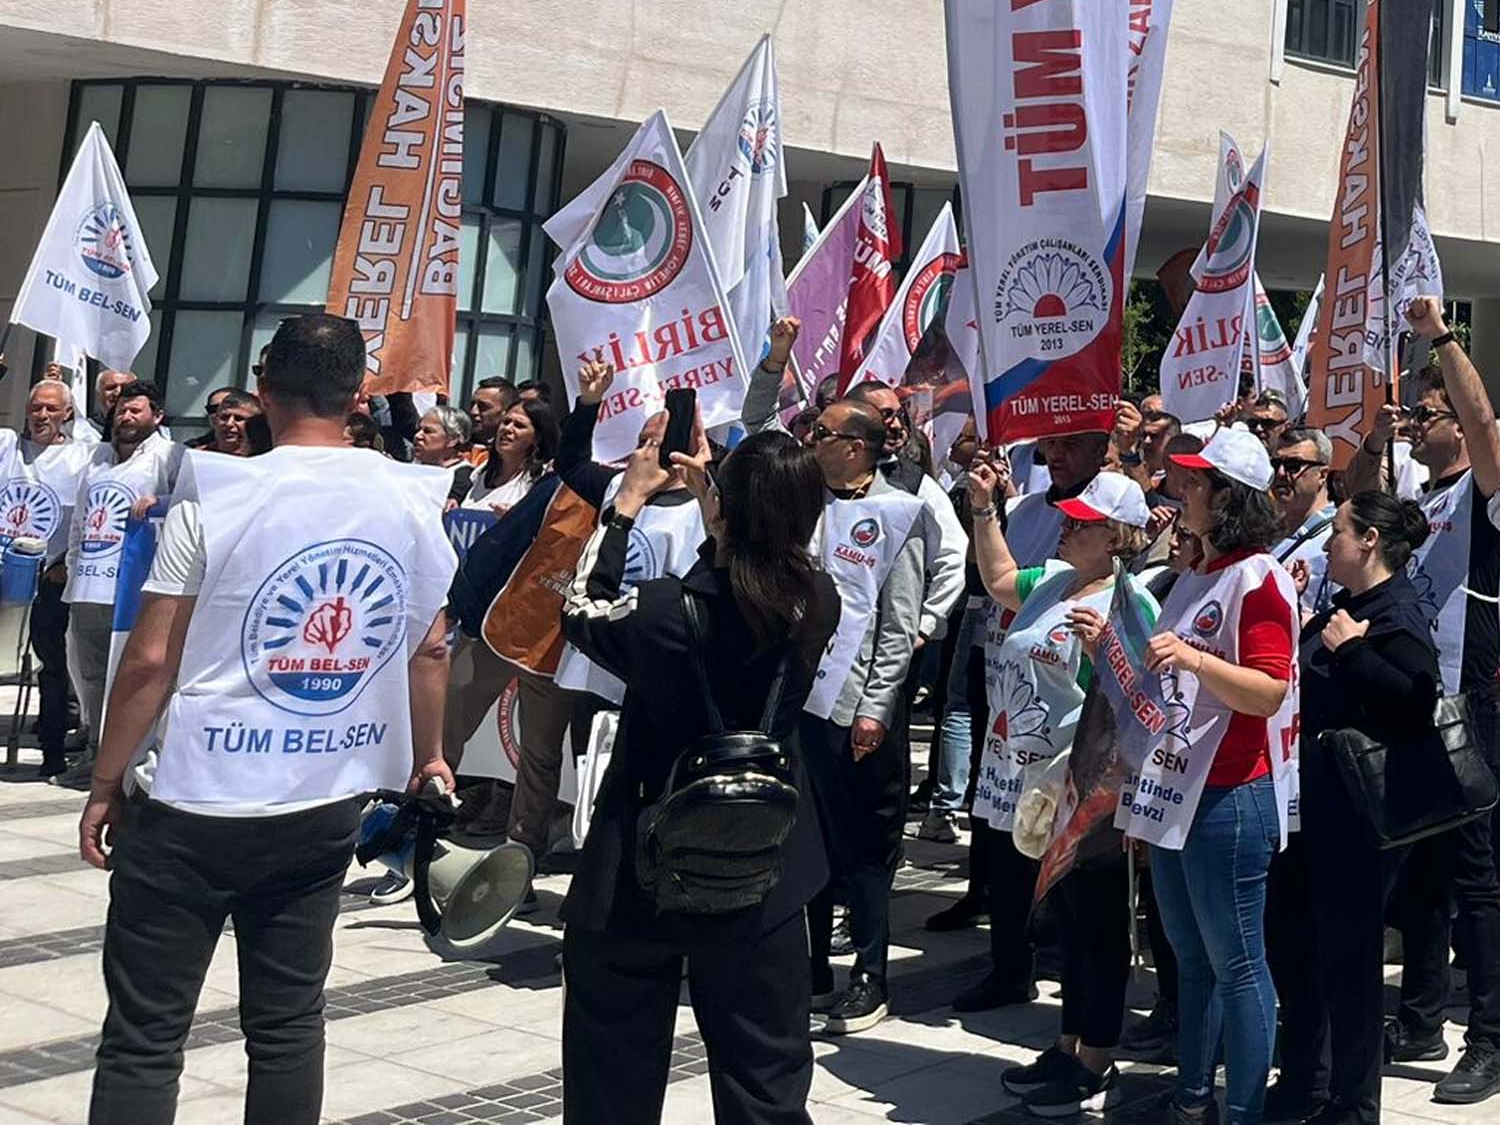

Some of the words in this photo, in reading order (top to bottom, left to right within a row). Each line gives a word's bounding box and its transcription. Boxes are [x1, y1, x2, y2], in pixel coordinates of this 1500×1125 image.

[1003, 28, 1087, 207] TÜM
[44, 269, 76, 297] TÜM
[78, 287, 141, 323] BEL-SEN
[1010, 321, 1033, 338] TÜM
[1034, 319, 1094, 336] YEREL-SEN
[1040, 339, 1064, 352] 2013
[1010, 393, 1040, 416] TÜM
[1041, 392, 1119, 414] YEREL-SEN
[77, 564, 120, 579] BEL-S
[267, 656, 305, 672] TÜM
[309, 657, 370, 673] BEL-SEN
[300, 677, 342, 691] 1990
[1104, 640, 1167, 737] YEREL-SEN
[203, 722, 273, 754] TÜM
[282, 722, 387, 754] BEL-SEN
